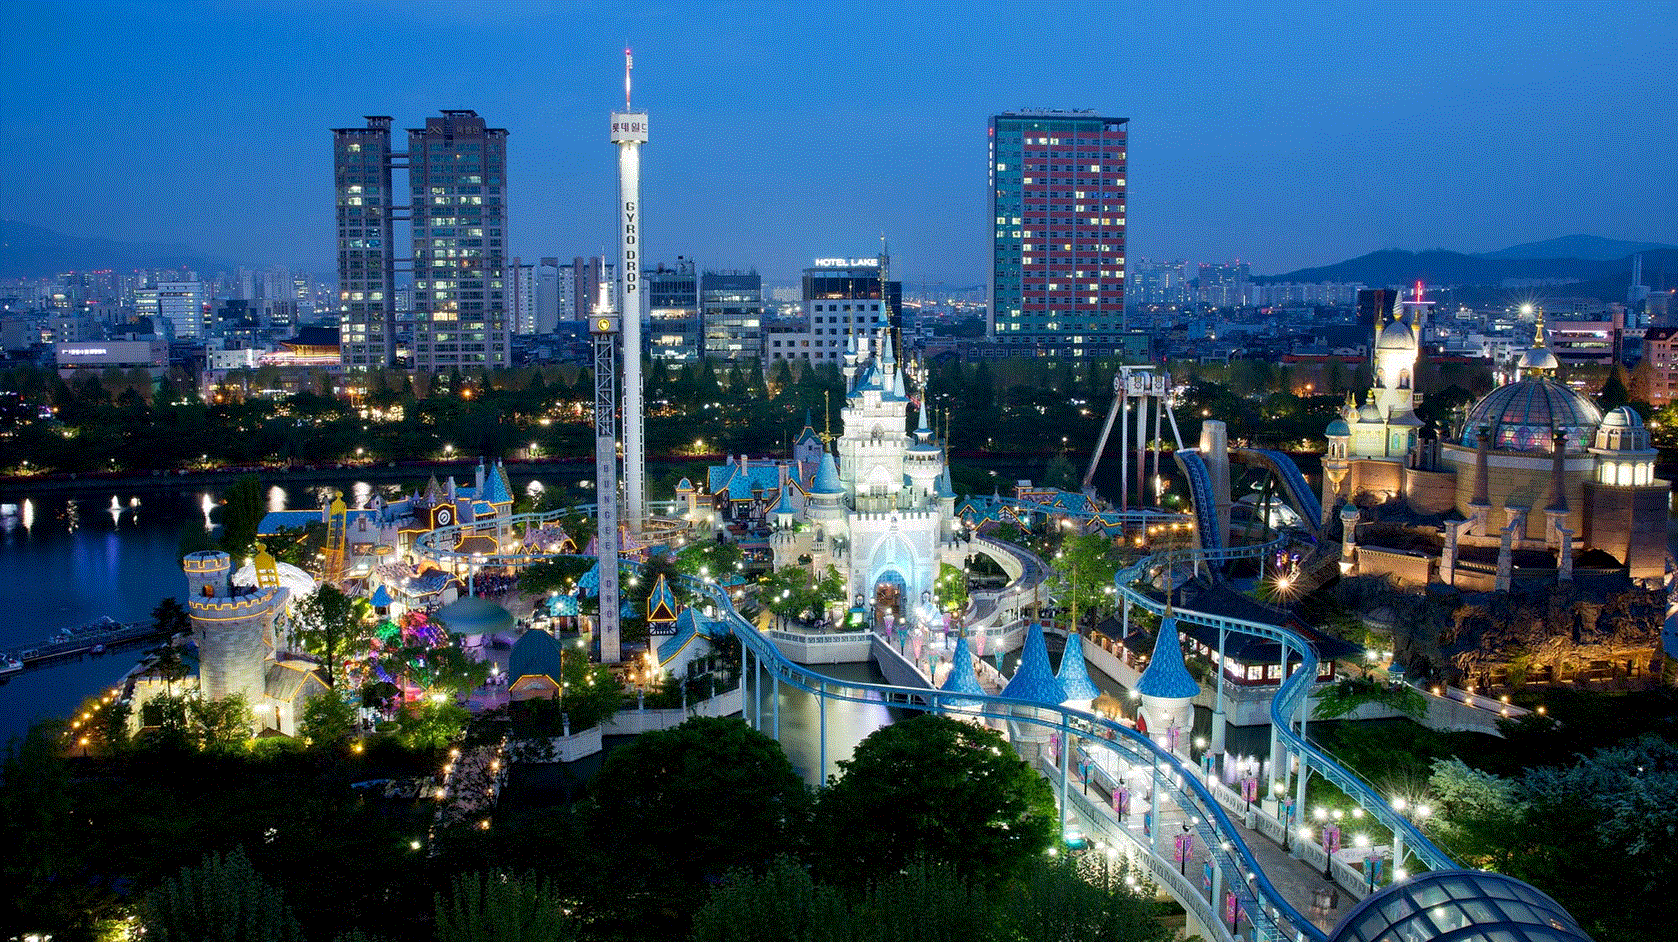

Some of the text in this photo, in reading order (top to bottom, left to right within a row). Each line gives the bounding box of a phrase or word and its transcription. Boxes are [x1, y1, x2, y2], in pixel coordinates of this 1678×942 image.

[625, 202, 636, 293] GYRO DROP
[815, 258, 878, 267] HOTEL LAKE
[603, 464, 611, 550] BUNGEE
